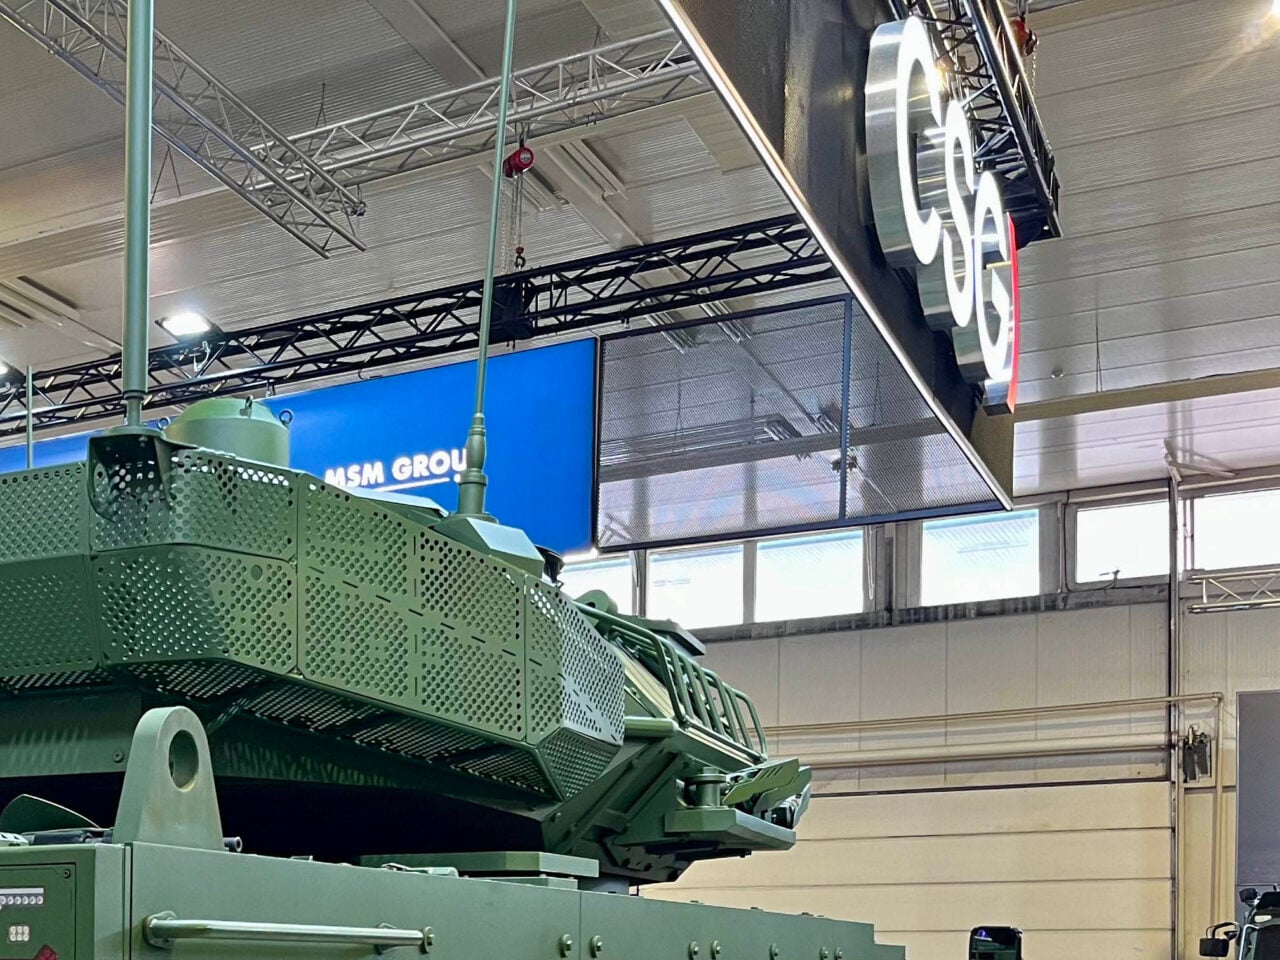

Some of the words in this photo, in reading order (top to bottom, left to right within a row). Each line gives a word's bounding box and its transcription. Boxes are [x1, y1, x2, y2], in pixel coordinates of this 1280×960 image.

[893, 14, 1012, 381] CSG
[324, 461, 384, 488] MSM
[392, 447, 468, 480] GROU
